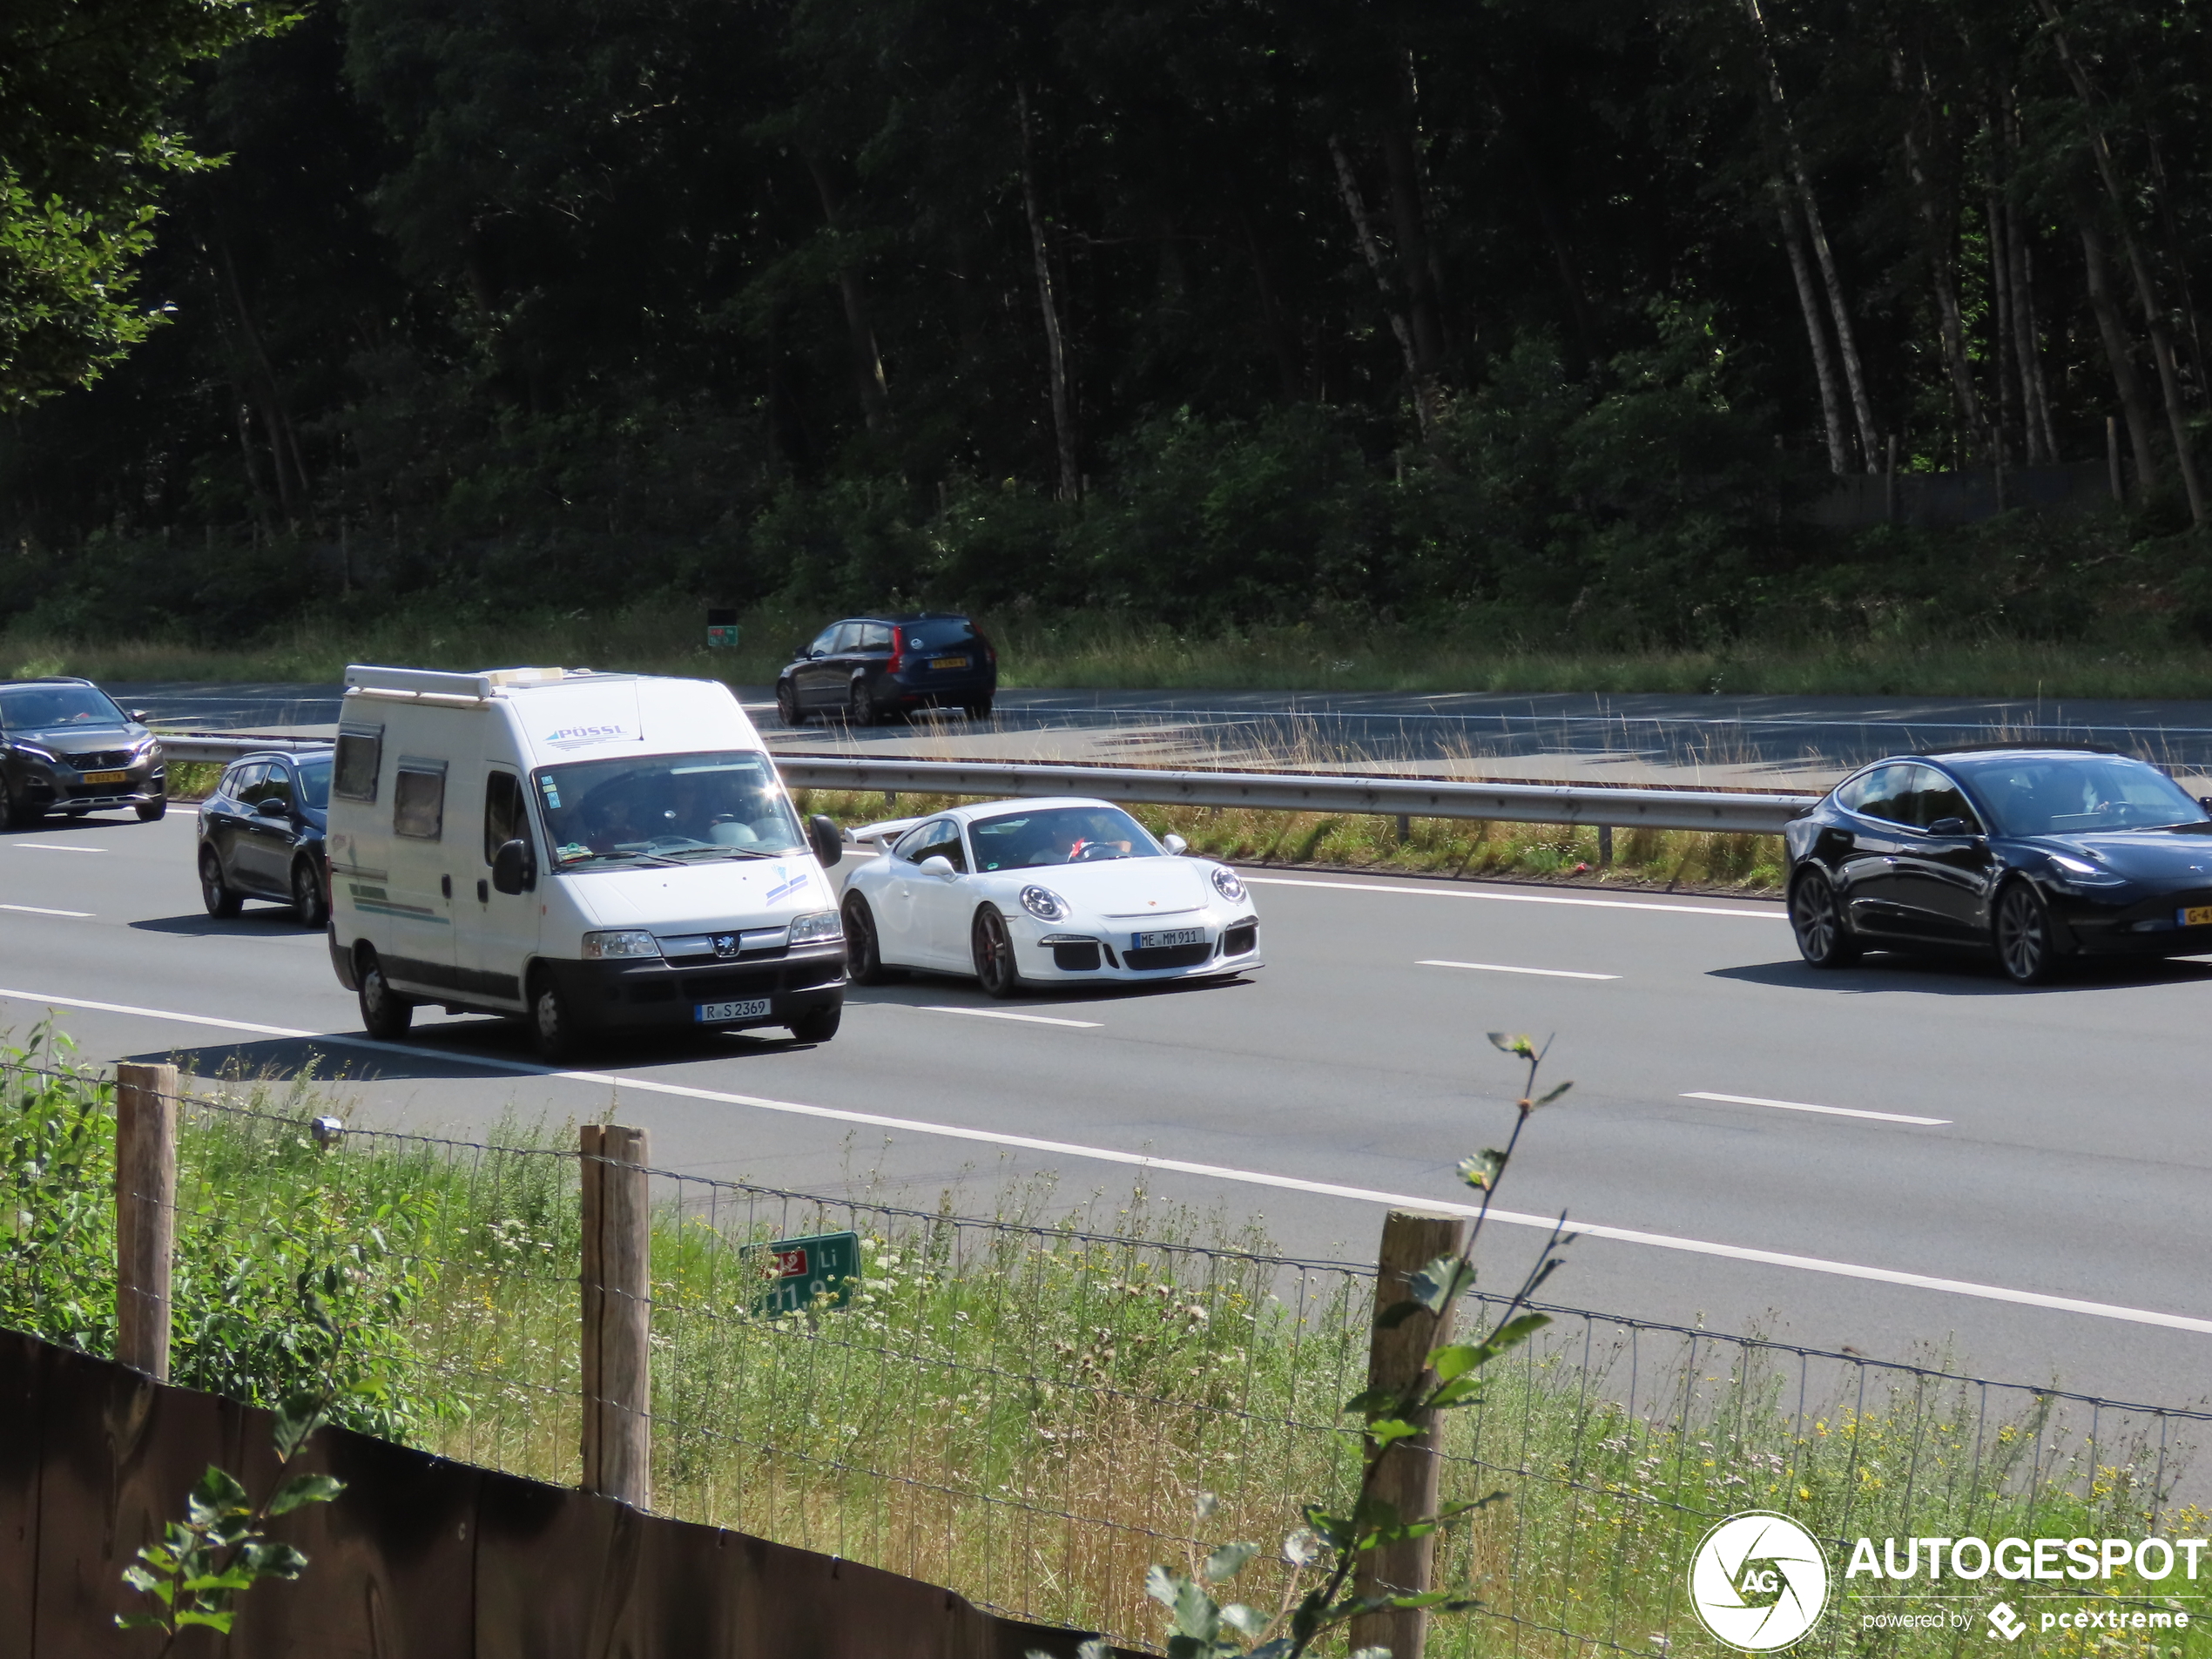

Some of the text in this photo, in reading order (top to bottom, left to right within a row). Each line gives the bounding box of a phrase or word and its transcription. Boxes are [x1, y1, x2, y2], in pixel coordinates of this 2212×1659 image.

[558, 725, 628, 738] PÖSSL
[1141, 930, 1197, 948] ME MM 911
[706, 1001, 765, 1019] R S 2369
[820, 1249, 837, 1268] Li
